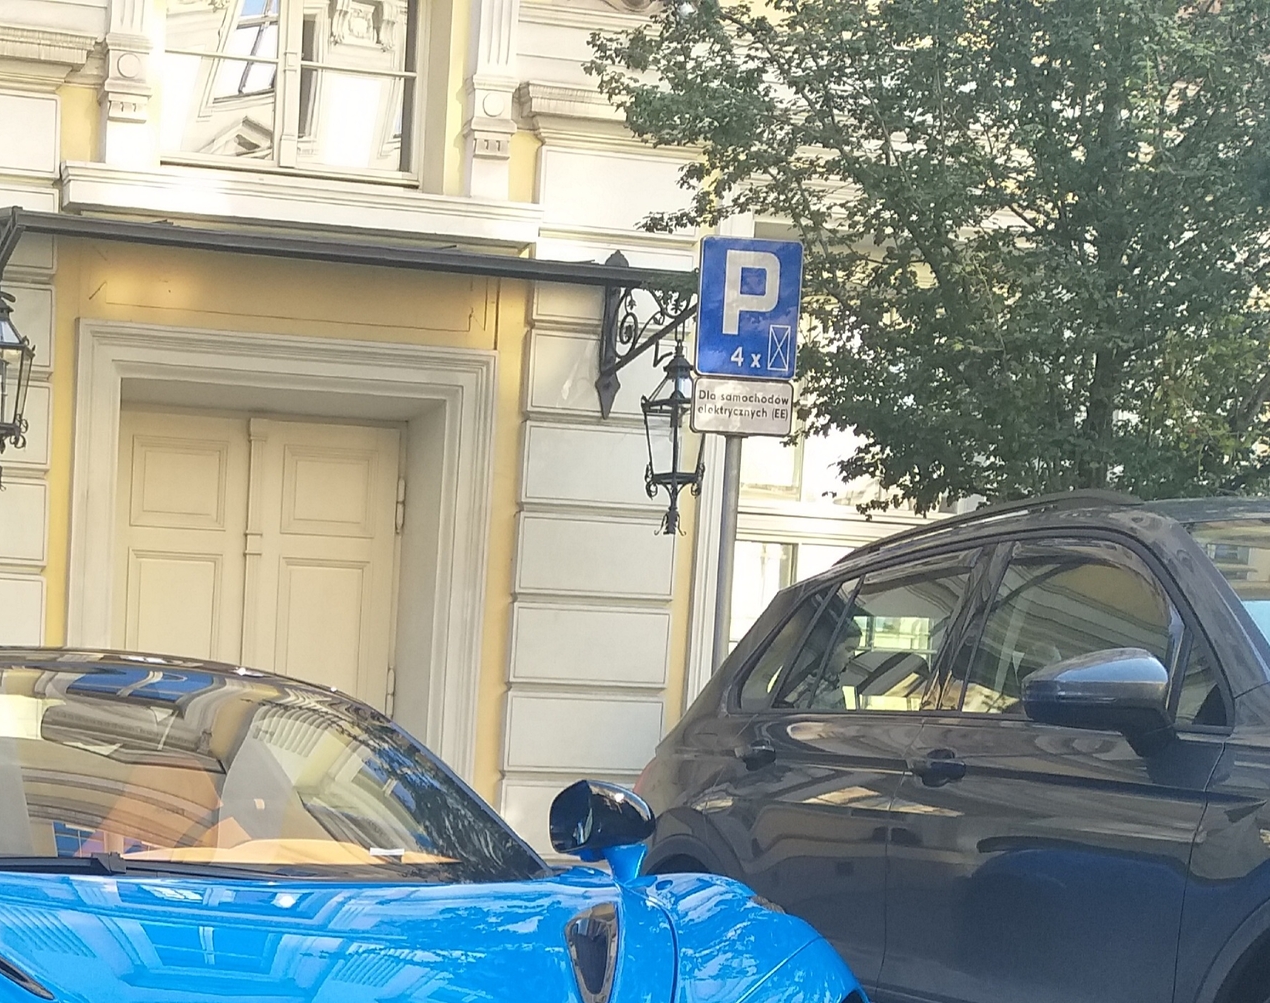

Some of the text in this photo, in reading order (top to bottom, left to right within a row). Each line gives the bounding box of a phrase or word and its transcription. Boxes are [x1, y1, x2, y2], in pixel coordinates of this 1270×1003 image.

[722, 249, 781, 335] P
[730, 346, 745, 367] 4
[698, 389, 790, 406] Dla samochodów
[697, 405, 789, 420] elektrycznych (EE)
